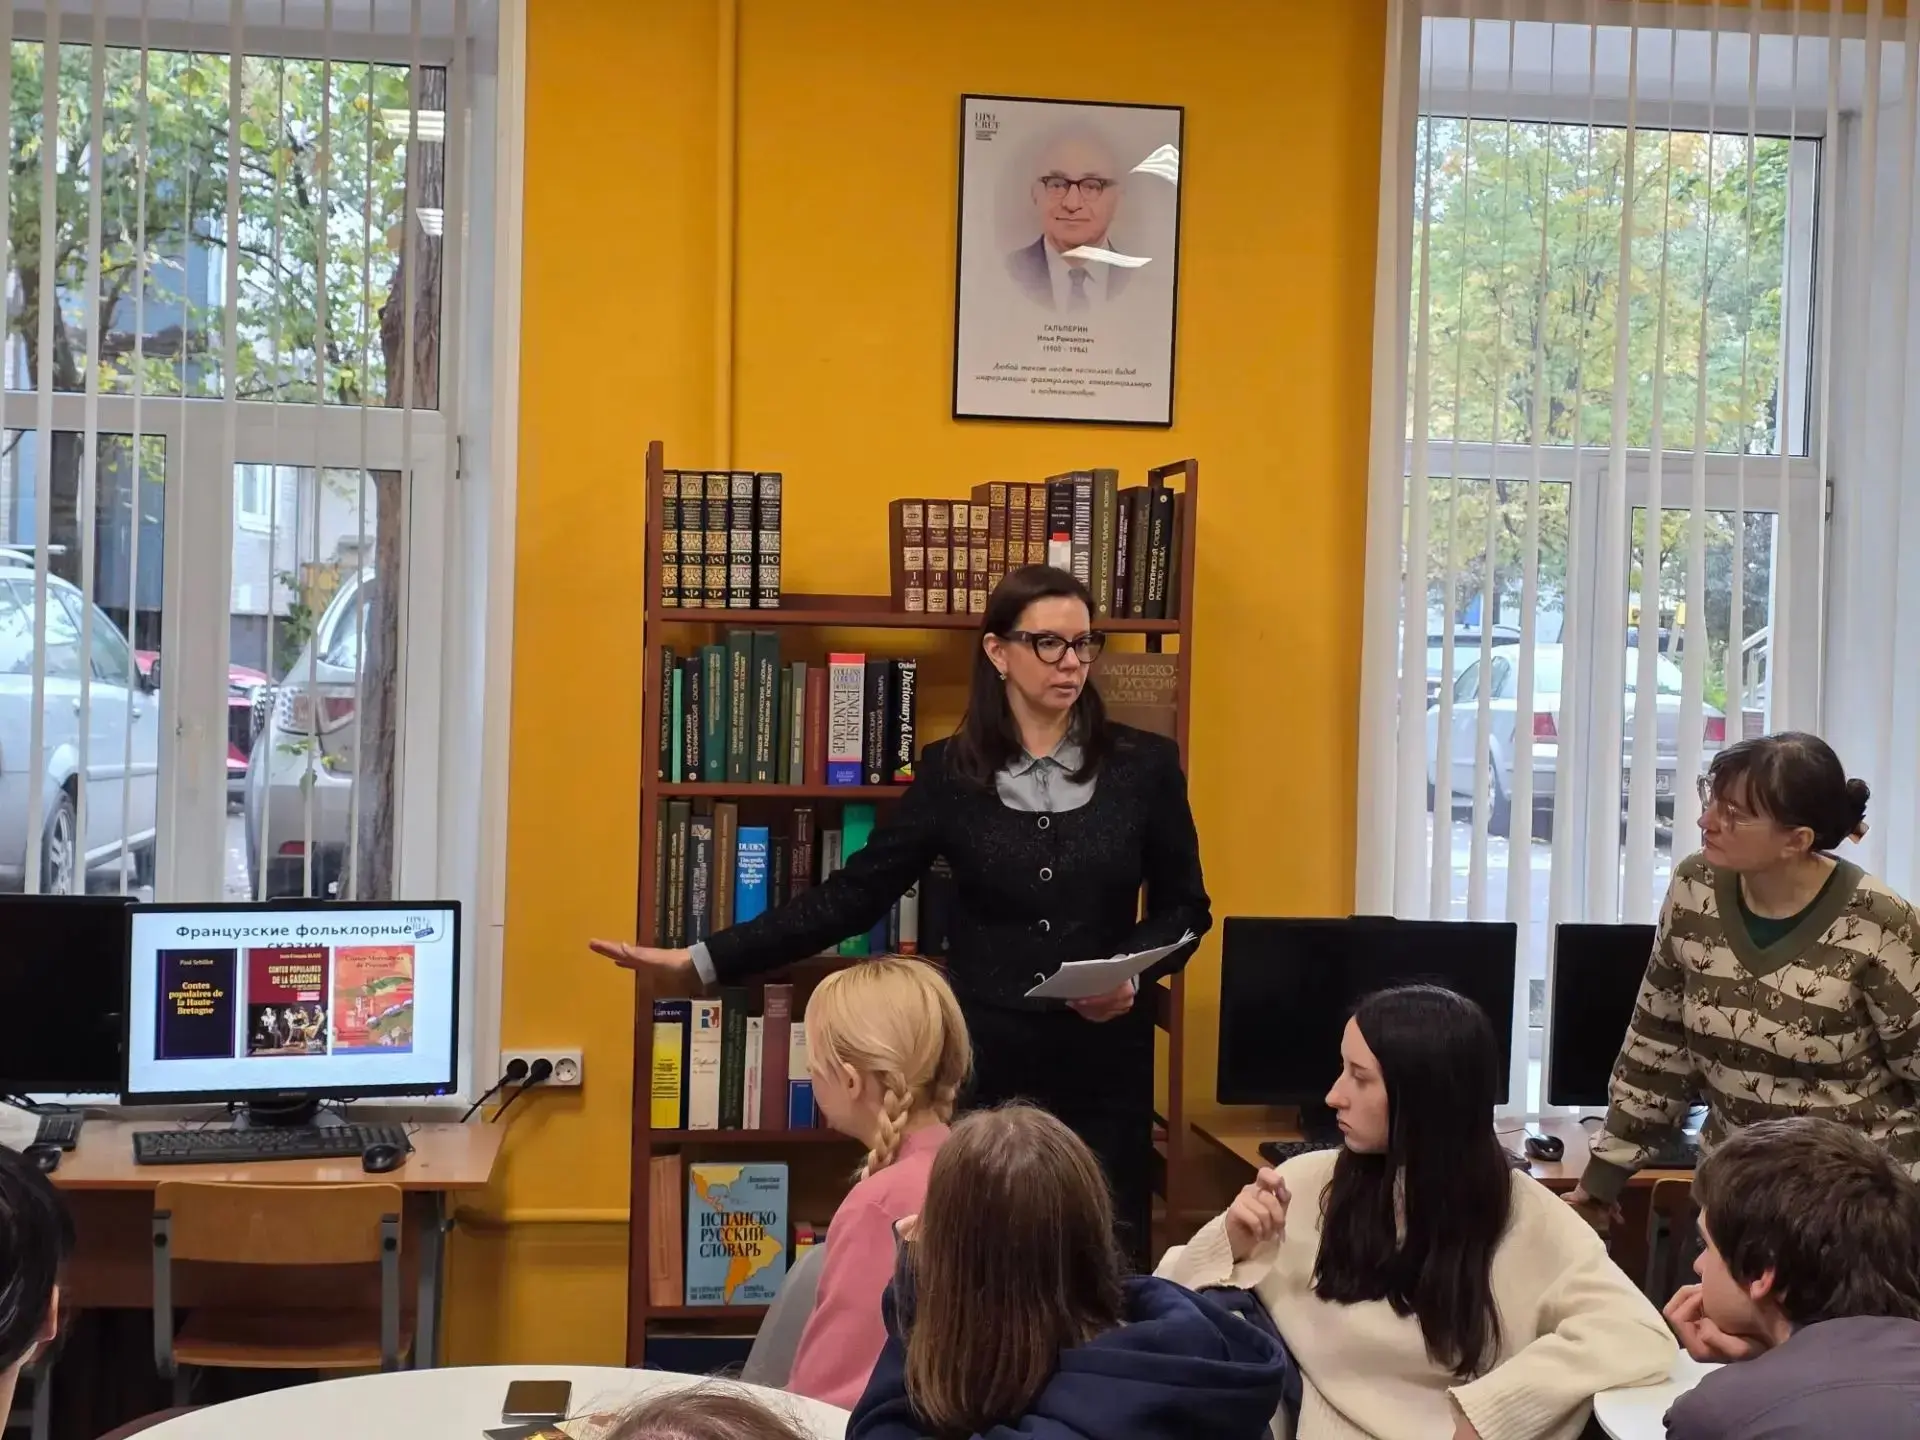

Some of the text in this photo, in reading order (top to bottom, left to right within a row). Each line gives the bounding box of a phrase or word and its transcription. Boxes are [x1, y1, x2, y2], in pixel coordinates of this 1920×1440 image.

[1044, 324, 1088, 333] ГАЛЬПЕРИН
[1056, 335, 1095, 344] Романович
[993, 362, 1019, 371] Любой
[1117, 676, 1176, 690] РУССКИЙ
[846, 690, 860, 742] ENGLISH
[898, 670, 914, 762] Dictionary & Usage
[832, 690, 847, 754] LANGUAGE
[738, 843, 766, 851] DUDEN
[176, 924, 289, 940] Французские
[295, 923, 412, 939] фольклорные
[268, 965, 321, 973] CONTES POPULAIRES
[272, 974, 321, 984] DE LA GASCOGNE
[169, 989, 223, 1000] populaires de
[177, 1007, 214, 1015] Bretagne
[700, 1225, 765, 1242] РУССКИЙ
[699, 1242, 762, 1258] СЛОВАРЬ
